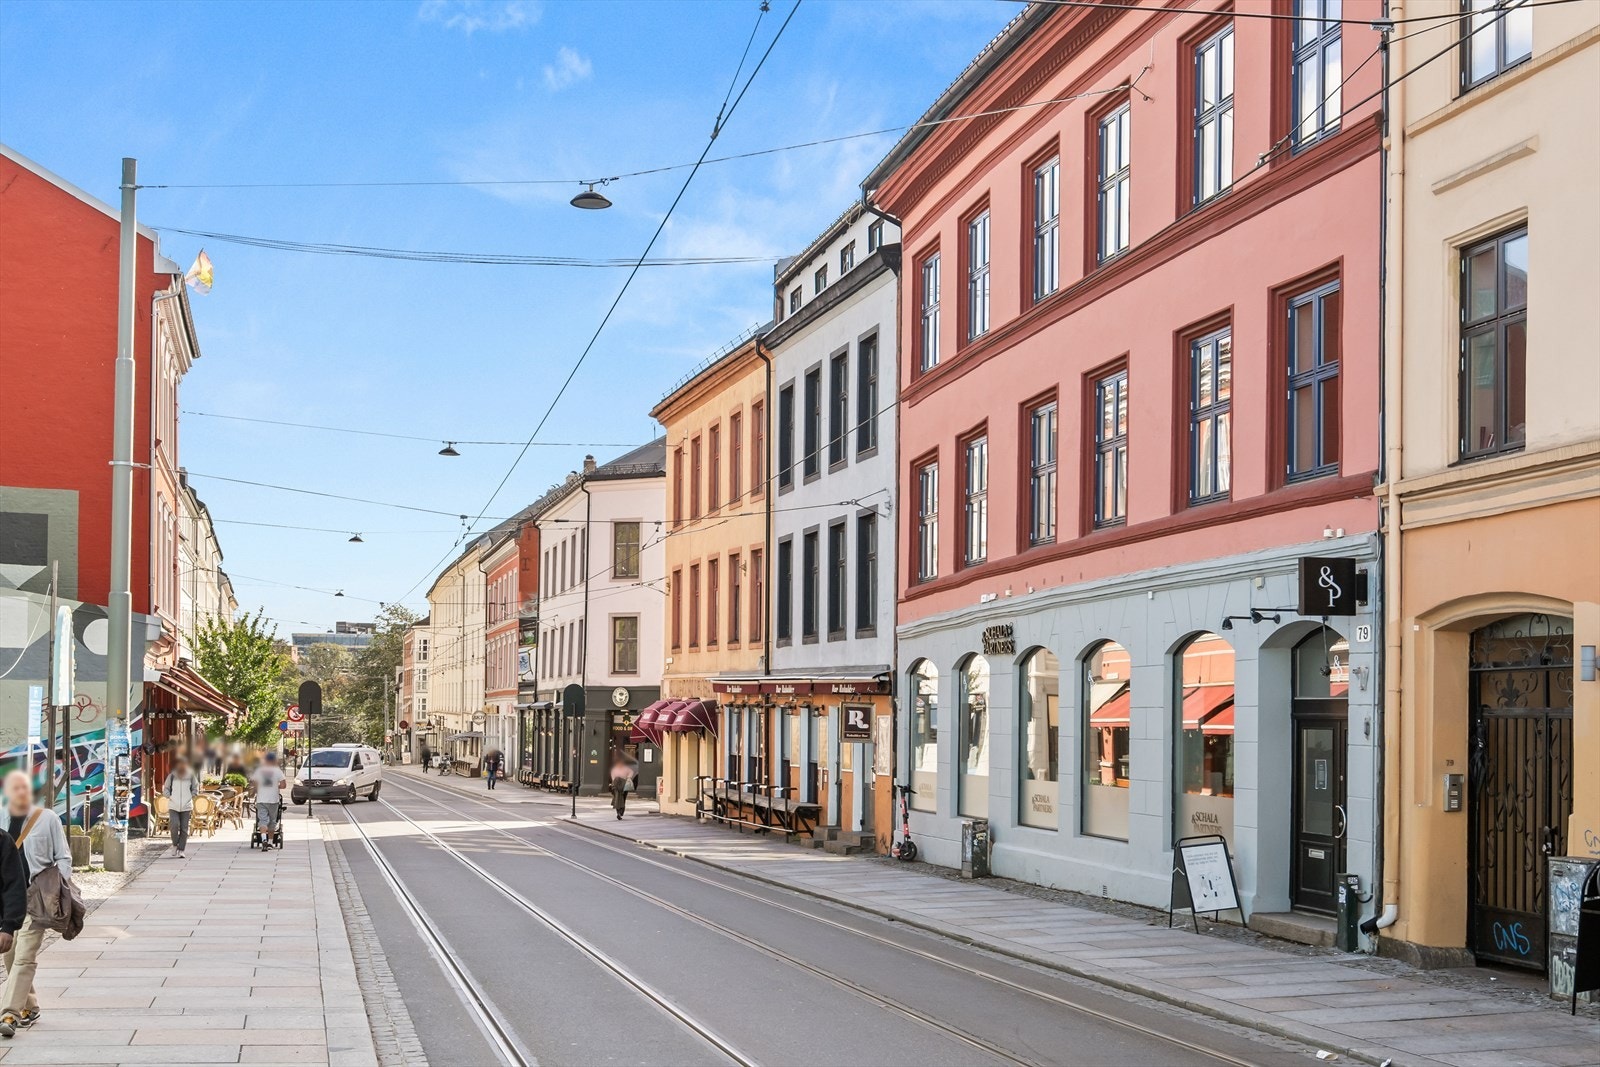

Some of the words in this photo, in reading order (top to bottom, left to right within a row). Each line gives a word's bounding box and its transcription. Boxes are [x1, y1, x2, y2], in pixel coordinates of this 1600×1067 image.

[1358, 626, 1369, 640] 79
[848, 710, 869, 729] R
[1446, 759, 1455, 767] 79
[1195, 811, 1219, 824] SCHALA
[1193, 822, 1223, 836] PARTNERS
[1493, 921, 1531, 955] CNS
